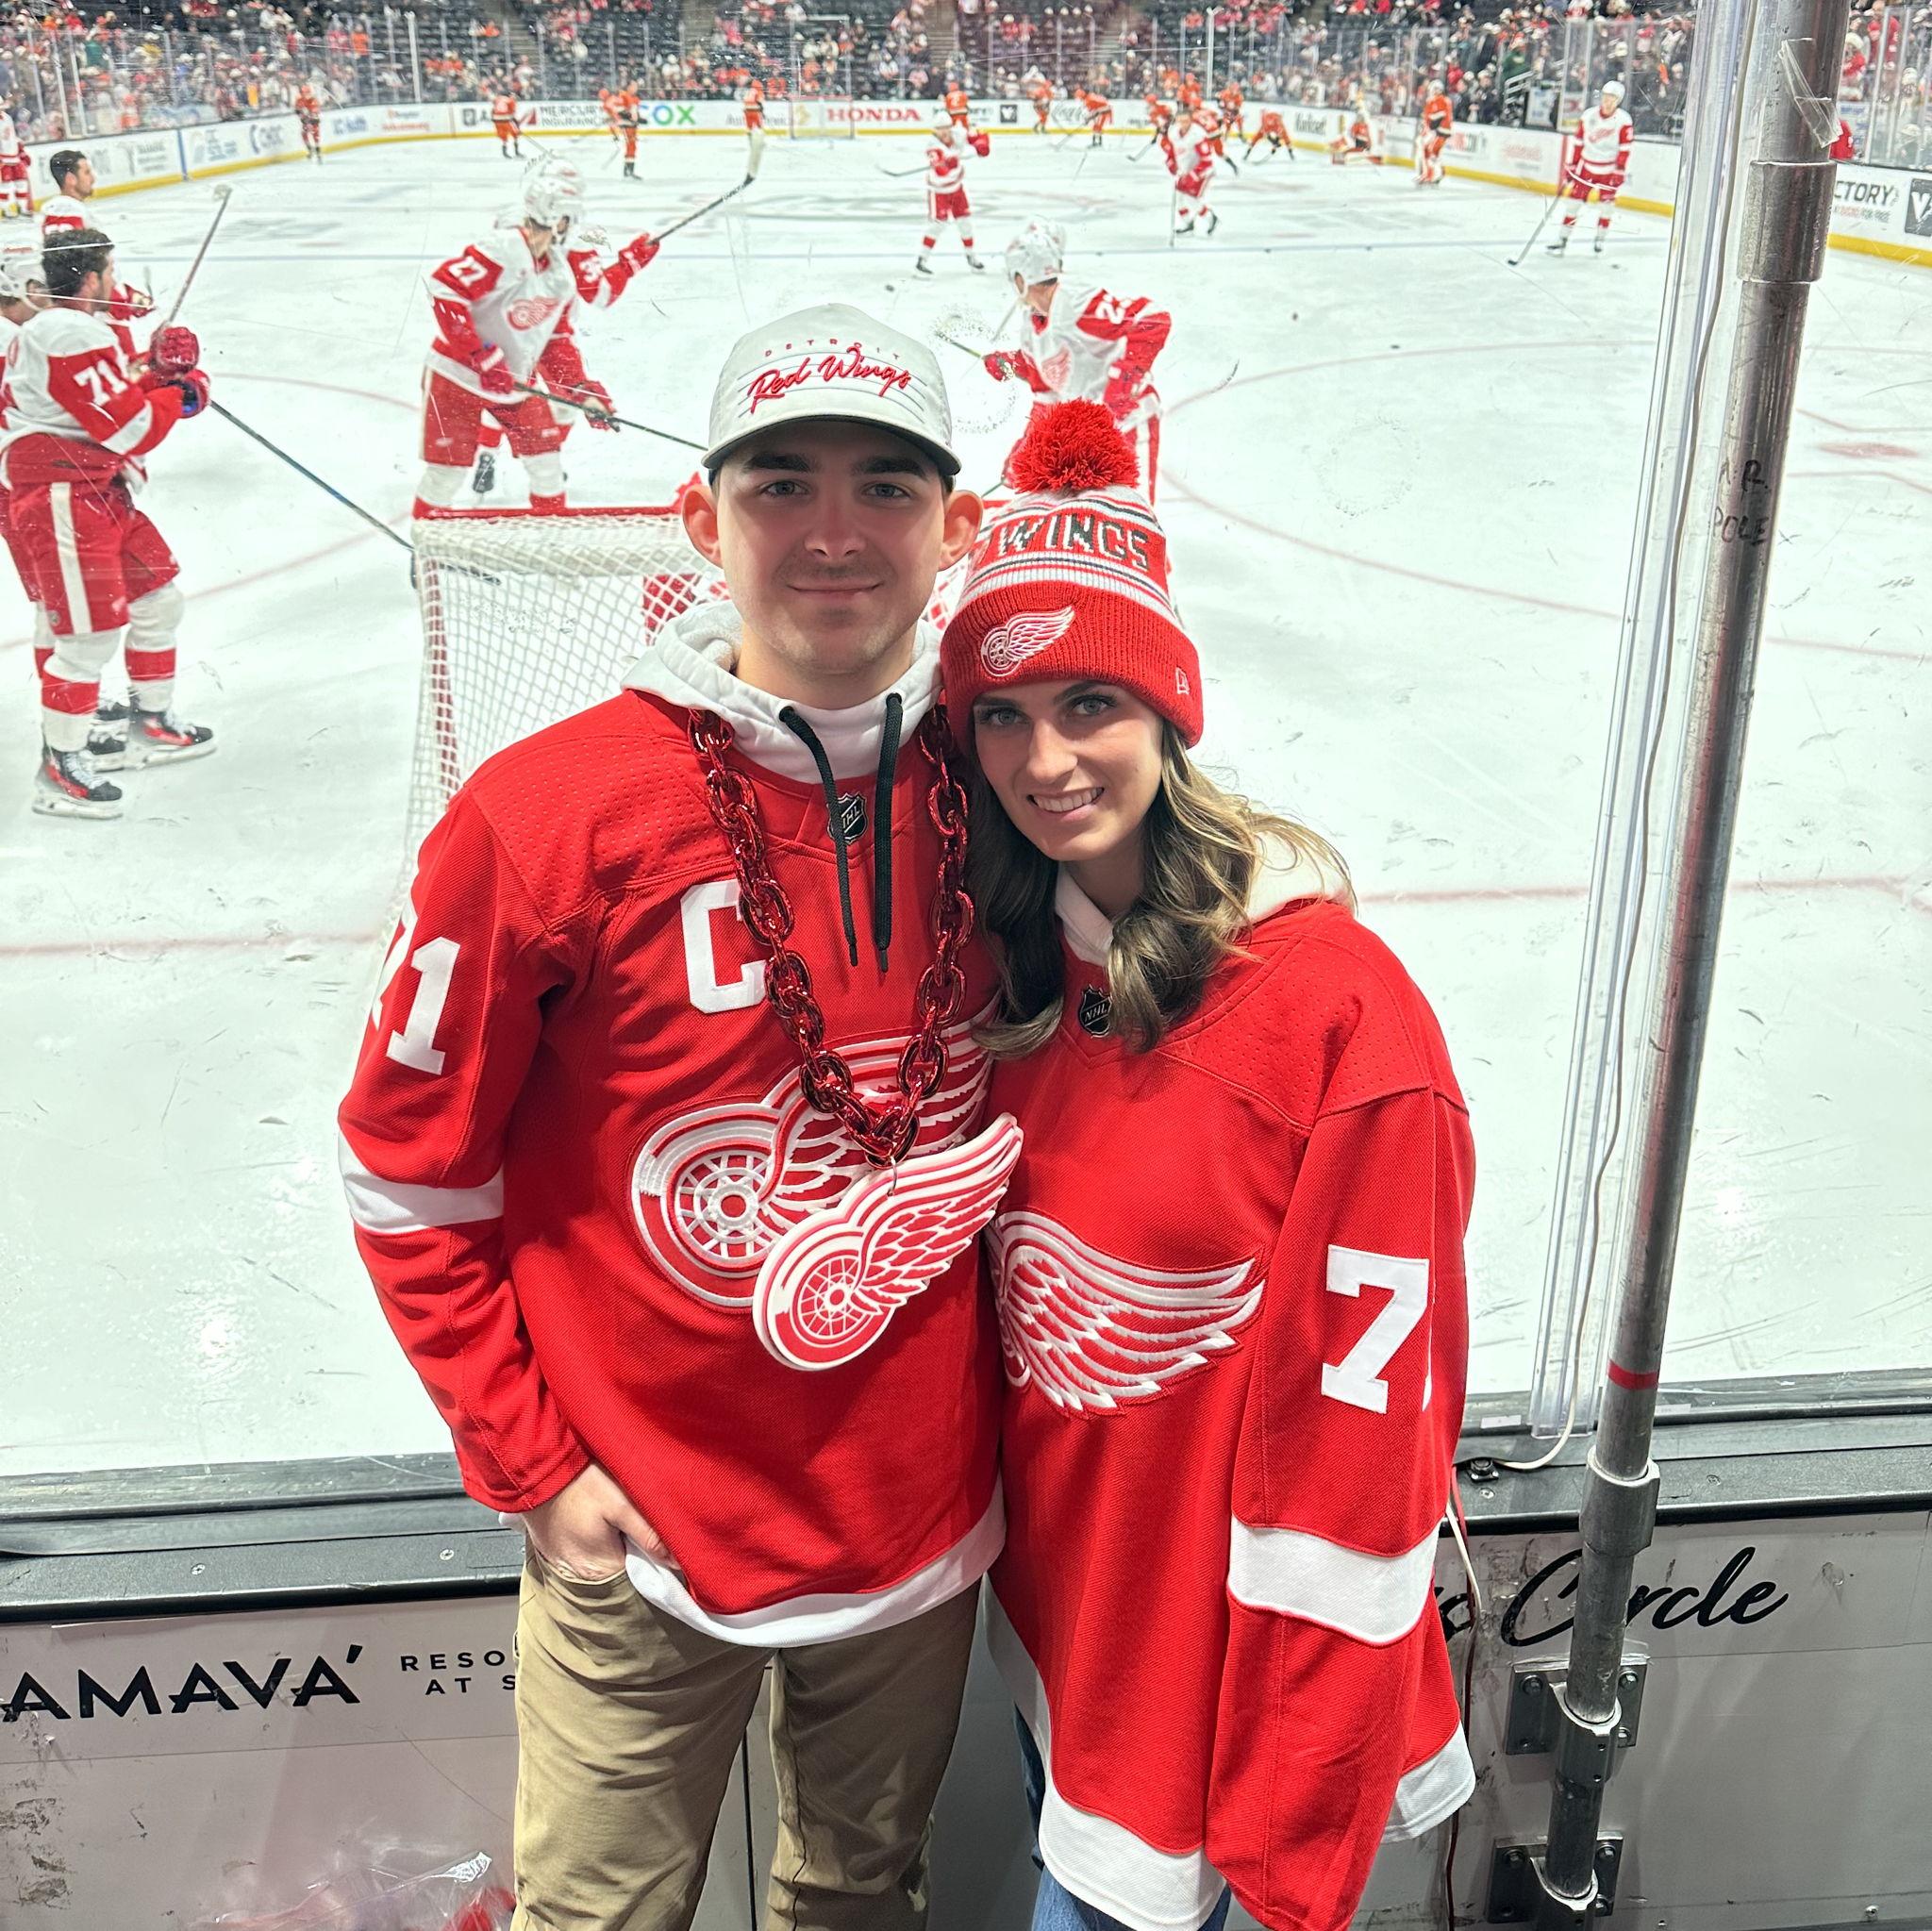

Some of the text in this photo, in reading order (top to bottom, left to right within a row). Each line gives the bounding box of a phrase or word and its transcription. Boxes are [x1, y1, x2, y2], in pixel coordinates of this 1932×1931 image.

[640, 105, 695, 125] OX
[827, 108, 922, 122] HONDA
[765, 338, 900, 360] DETROIT
[74, 358, 128, 407] 71
[747, 346, 911, 414] Red Wings
[998, 513, 1151, 572] WINGS
[680, 879, 767, 1014] C
[1084, 1003, 1108, 1023] NHL
[1321, 1243, 1433, 1414] 7
[1501, 1546, 1789, 1647] Crcle
[400, 1650, 506, 1672] RESO
[425, 1677, 472, 1696] AT
